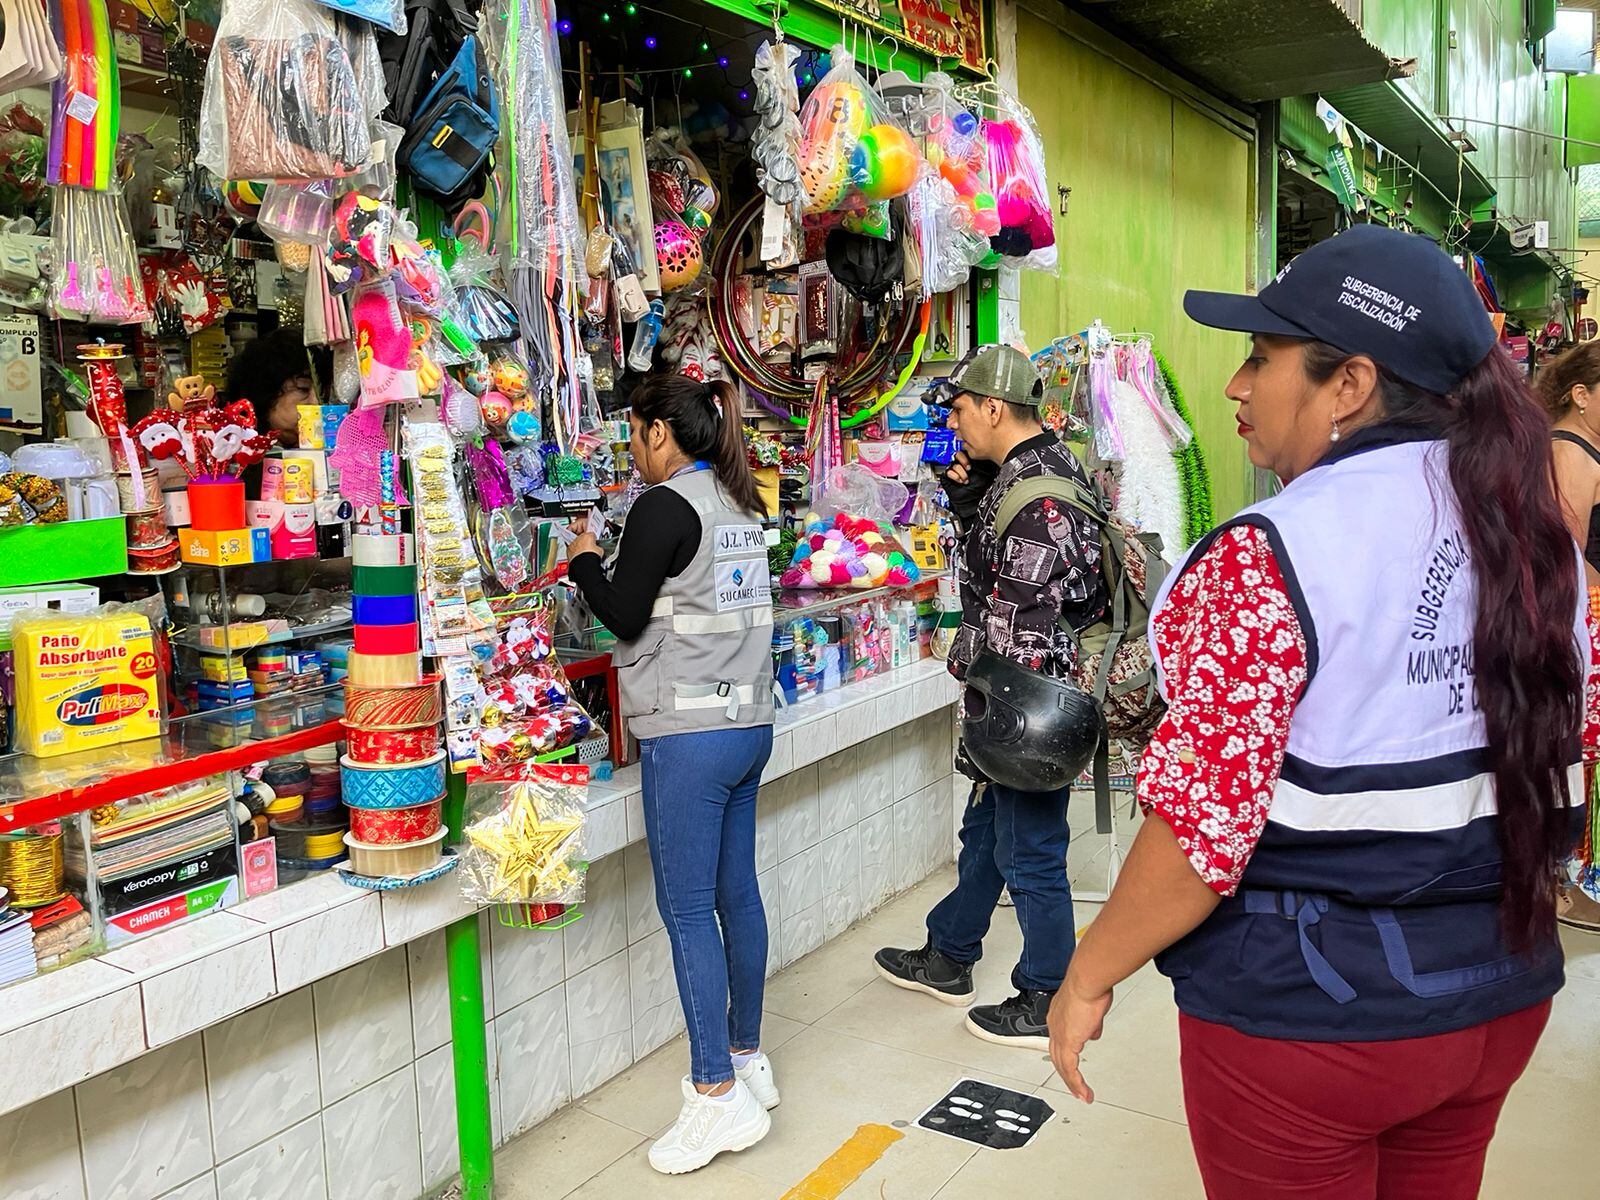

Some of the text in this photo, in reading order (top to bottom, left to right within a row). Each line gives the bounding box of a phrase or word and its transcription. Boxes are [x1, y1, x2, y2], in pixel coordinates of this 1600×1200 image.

[1335, 151, 1356, 194] PALMOLIVE
[1337, 291, 1408, 332] FISCALIZACIÓN
[1342, 275, 1422, 321] SUBGERENCIA DE
[0, 329, 38, 337] OMPLEJO
[22, 336, 36, 355] B
[721, 531, 742, 549] J.Z.
[1411, 529, 1470, 642] SUBGERENCIA
[40, 646, 127, 665] Absorbente
[41, 634, 80, 648] Paño
[135, 655, 156, 670] 20
[1407, 642, 1476, 685] MUNICIPAL
[61, 692, 147, 720] PuliMax
[1448, 682, 1465, 717] DE
[129, 906, 171, 929] CHAMEX
[192, 897, 203, 907] A4
[203, 893, 216, 903] 75
